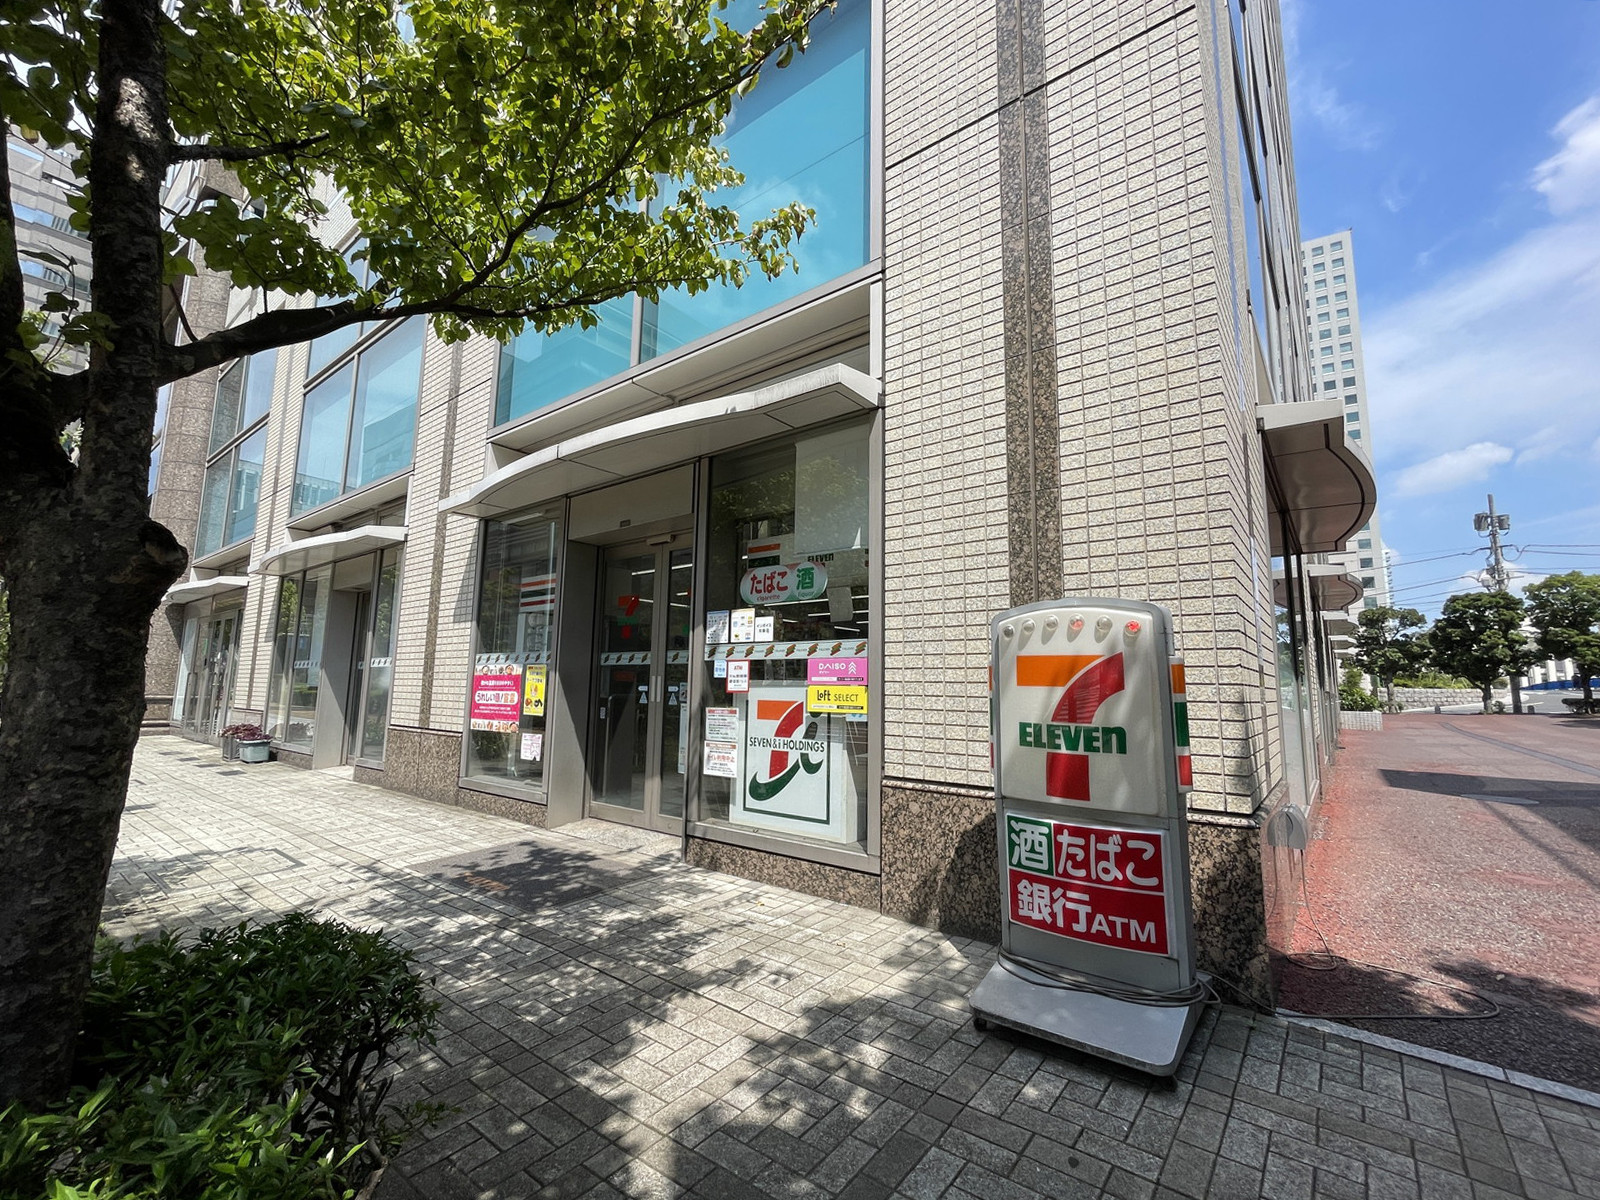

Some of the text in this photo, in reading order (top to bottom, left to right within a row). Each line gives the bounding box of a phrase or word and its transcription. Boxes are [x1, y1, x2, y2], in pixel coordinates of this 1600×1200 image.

[750, 567, 814, 595] たばこ 酒
[834, 693, 859, 702] SELECT
[782, 739, 825, 753] HOLDINGS
[1010, 819, 1160, 886] 酒 たばこ
[1016, 879, 1157, 945] 銀行 ATM
